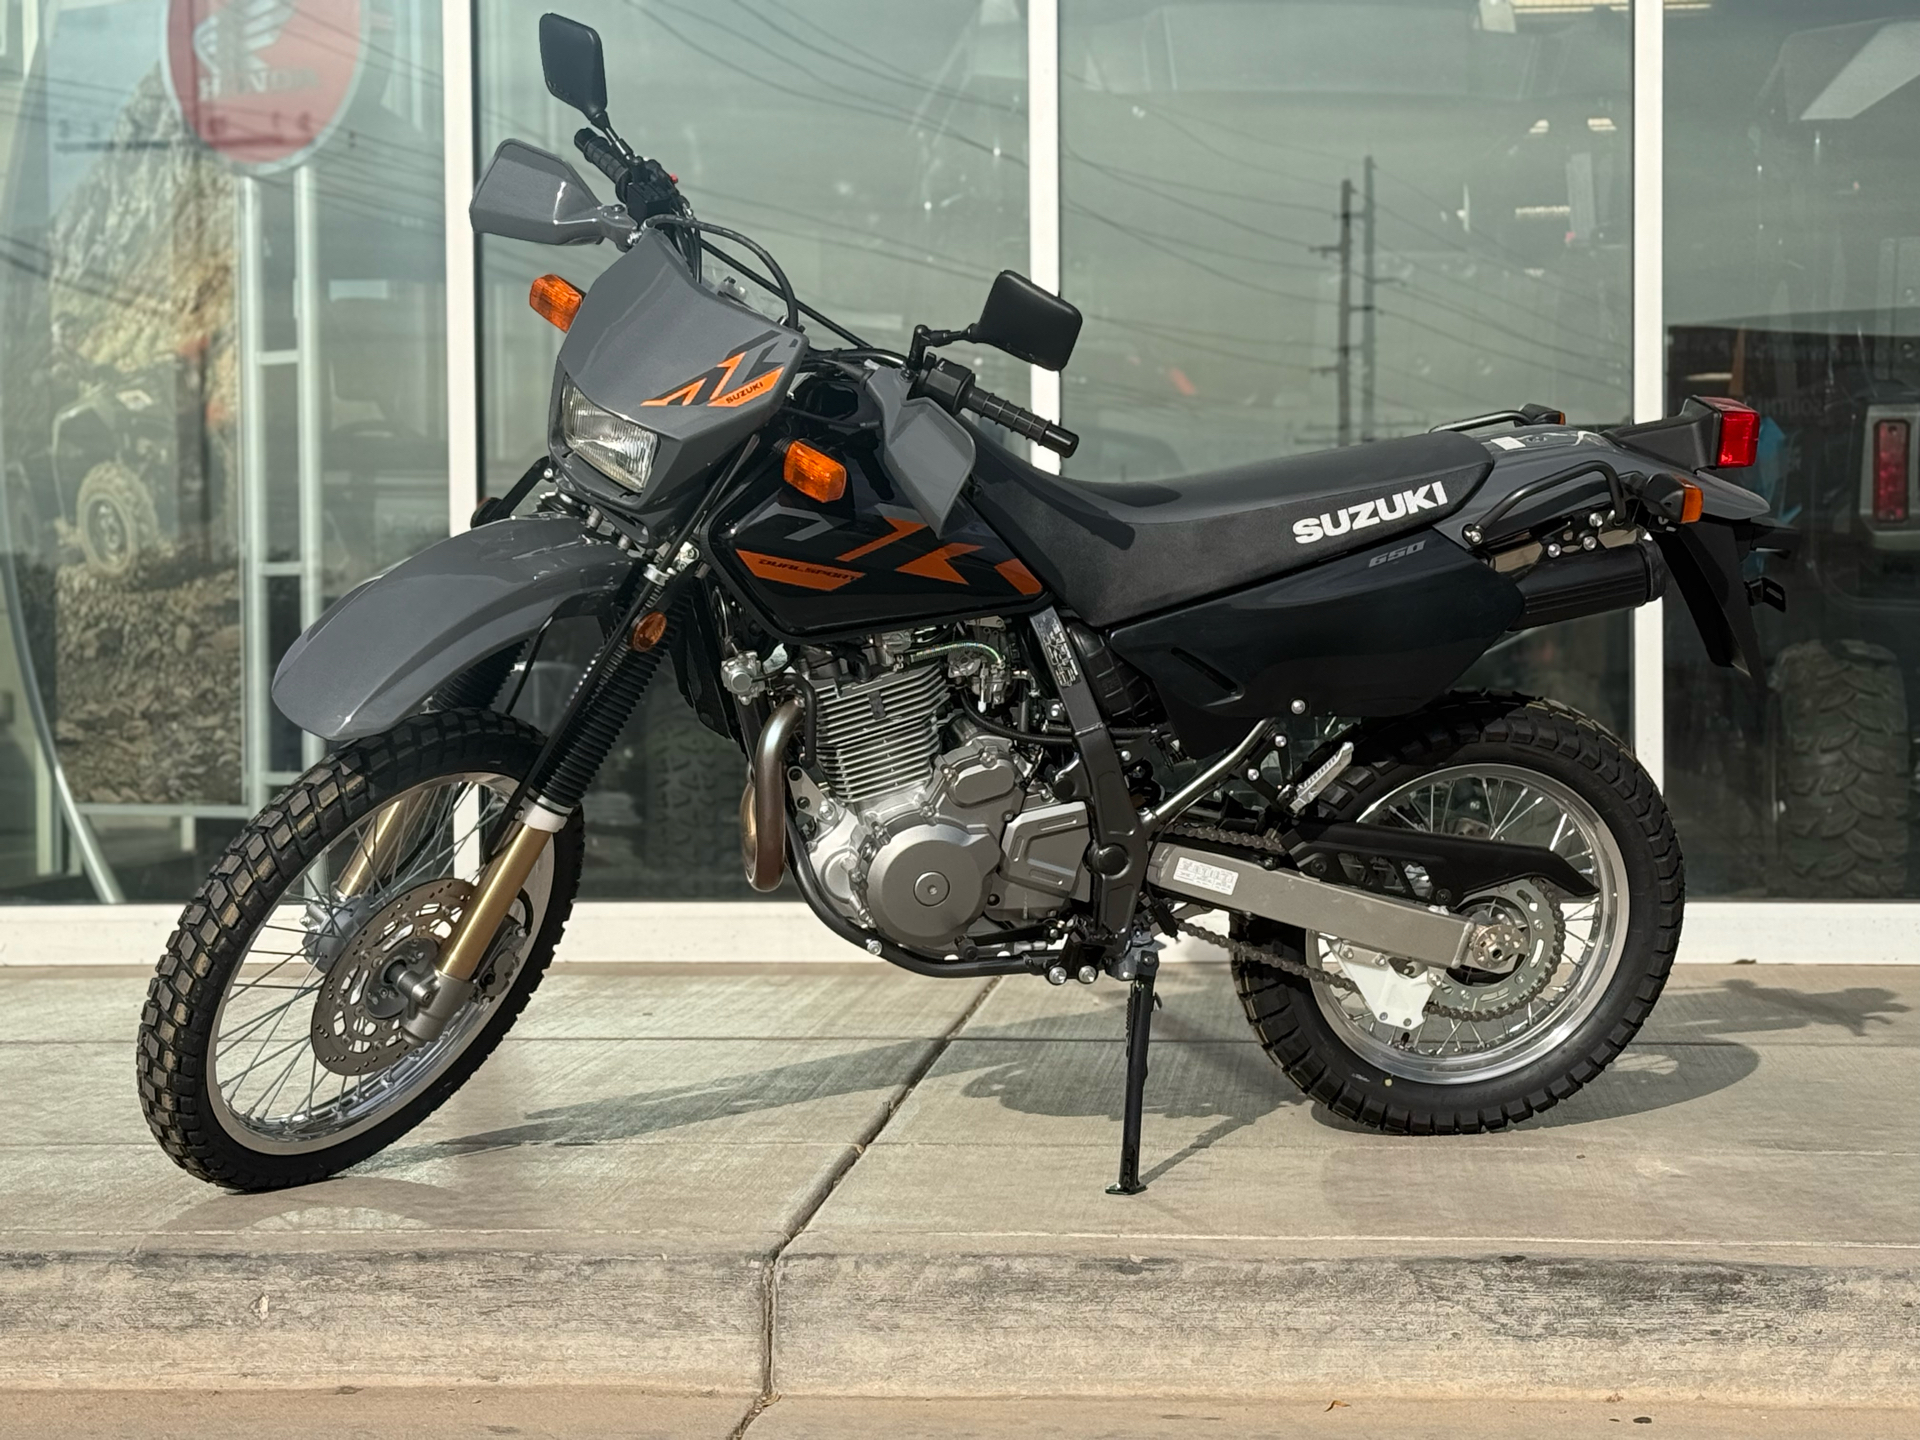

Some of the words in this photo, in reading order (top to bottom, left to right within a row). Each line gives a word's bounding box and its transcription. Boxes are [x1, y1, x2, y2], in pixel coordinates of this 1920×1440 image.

[199, 68, 318, 101] HND
[725, 381, 764, 404] SUZUKI
[1292, 481, 1448, 544] SUZUKI
[1368, 540, 1426, 568] 650
